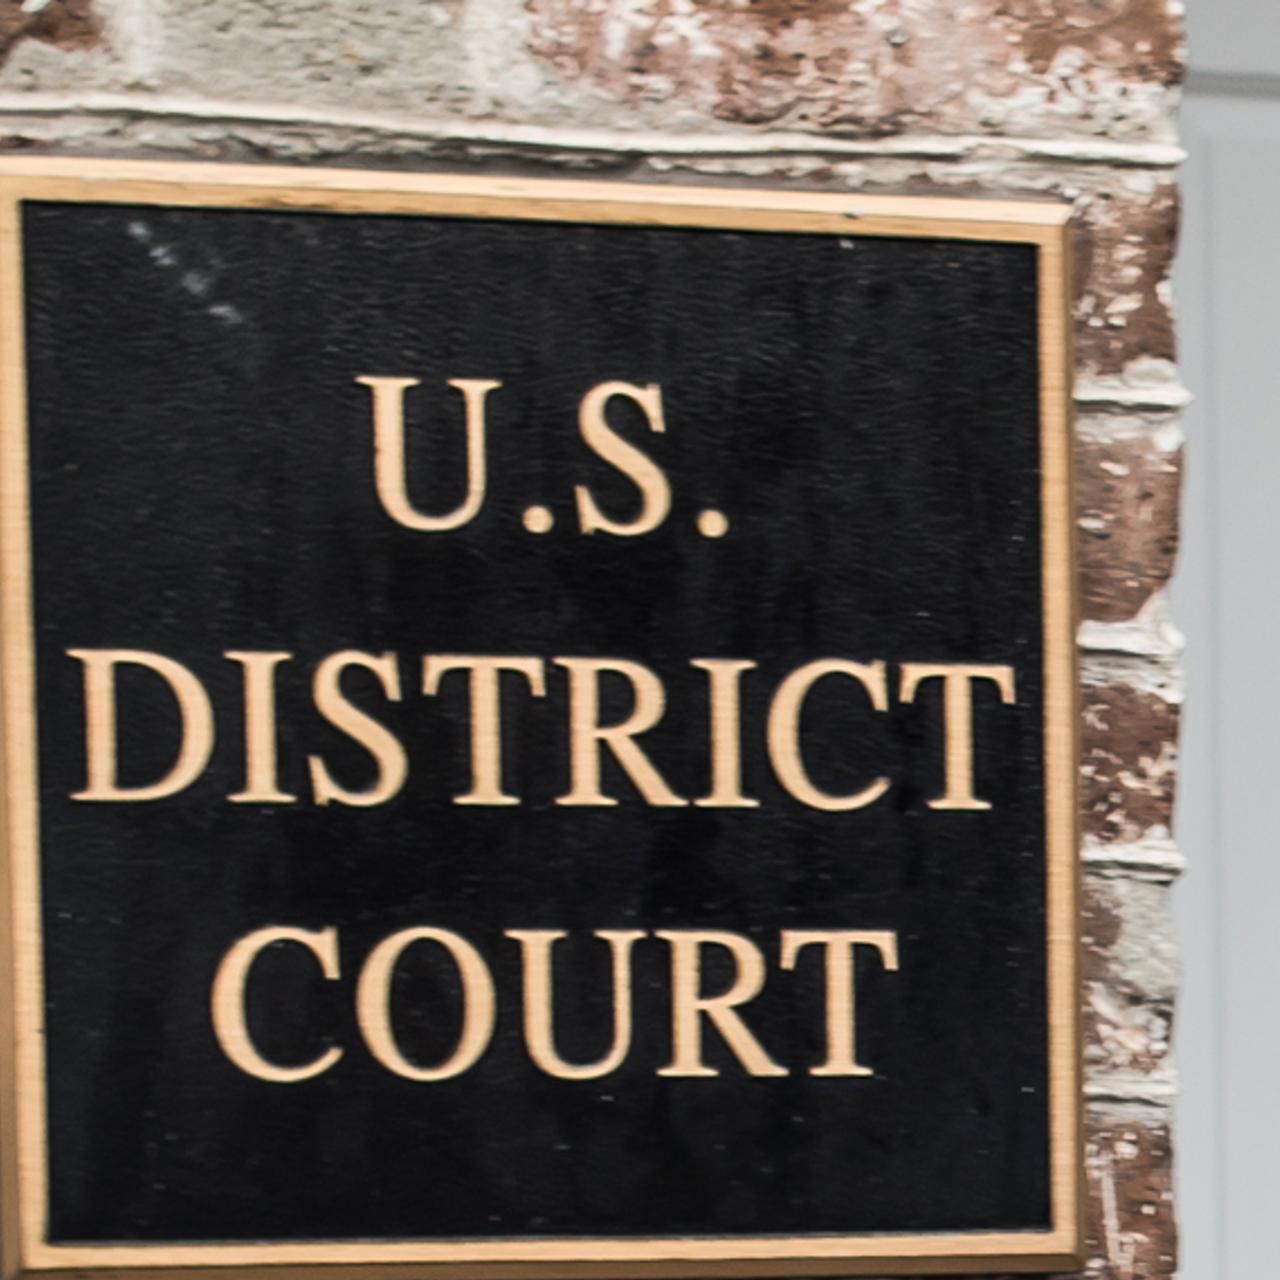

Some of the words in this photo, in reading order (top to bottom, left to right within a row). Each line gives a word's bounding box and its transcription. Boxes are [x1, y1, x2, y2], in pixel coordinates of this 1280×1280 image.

[356, 375, 728, 538] U.S.
[66, 649, 1016, 811] DISTRICT
[212, 926, 899, 1082] COURT
